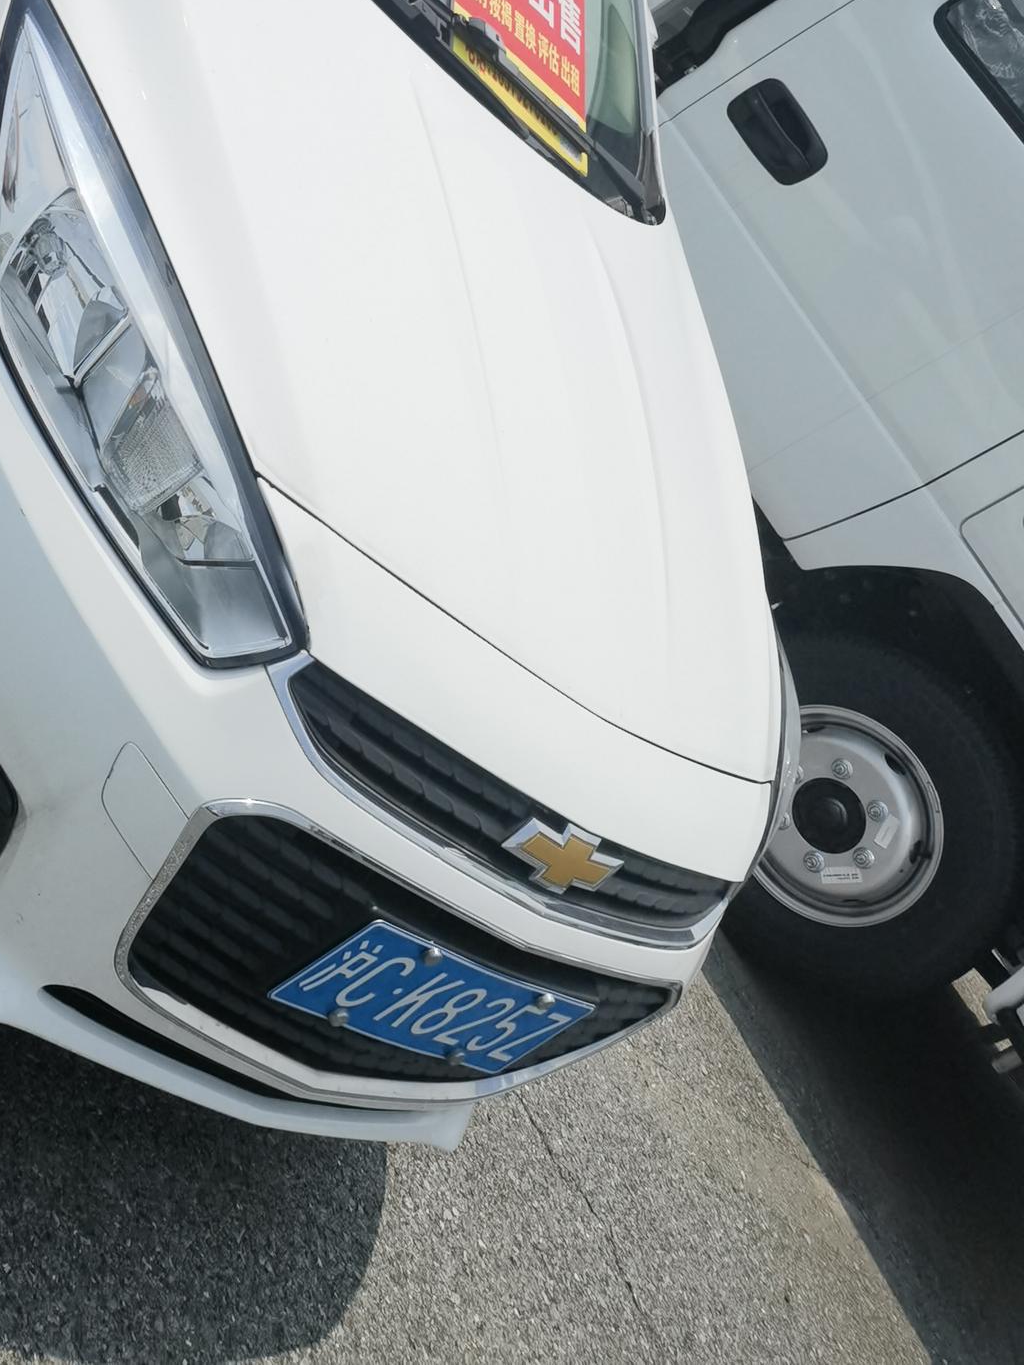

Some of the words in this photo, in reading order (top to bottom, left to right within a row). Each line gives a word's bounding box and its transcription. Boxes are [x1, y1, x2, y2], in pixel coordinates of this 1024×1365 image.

[514, 10, 537, 54] 置换
[538, 32, 559, 76] 评估
[561, 56, 581, 97] 出租
